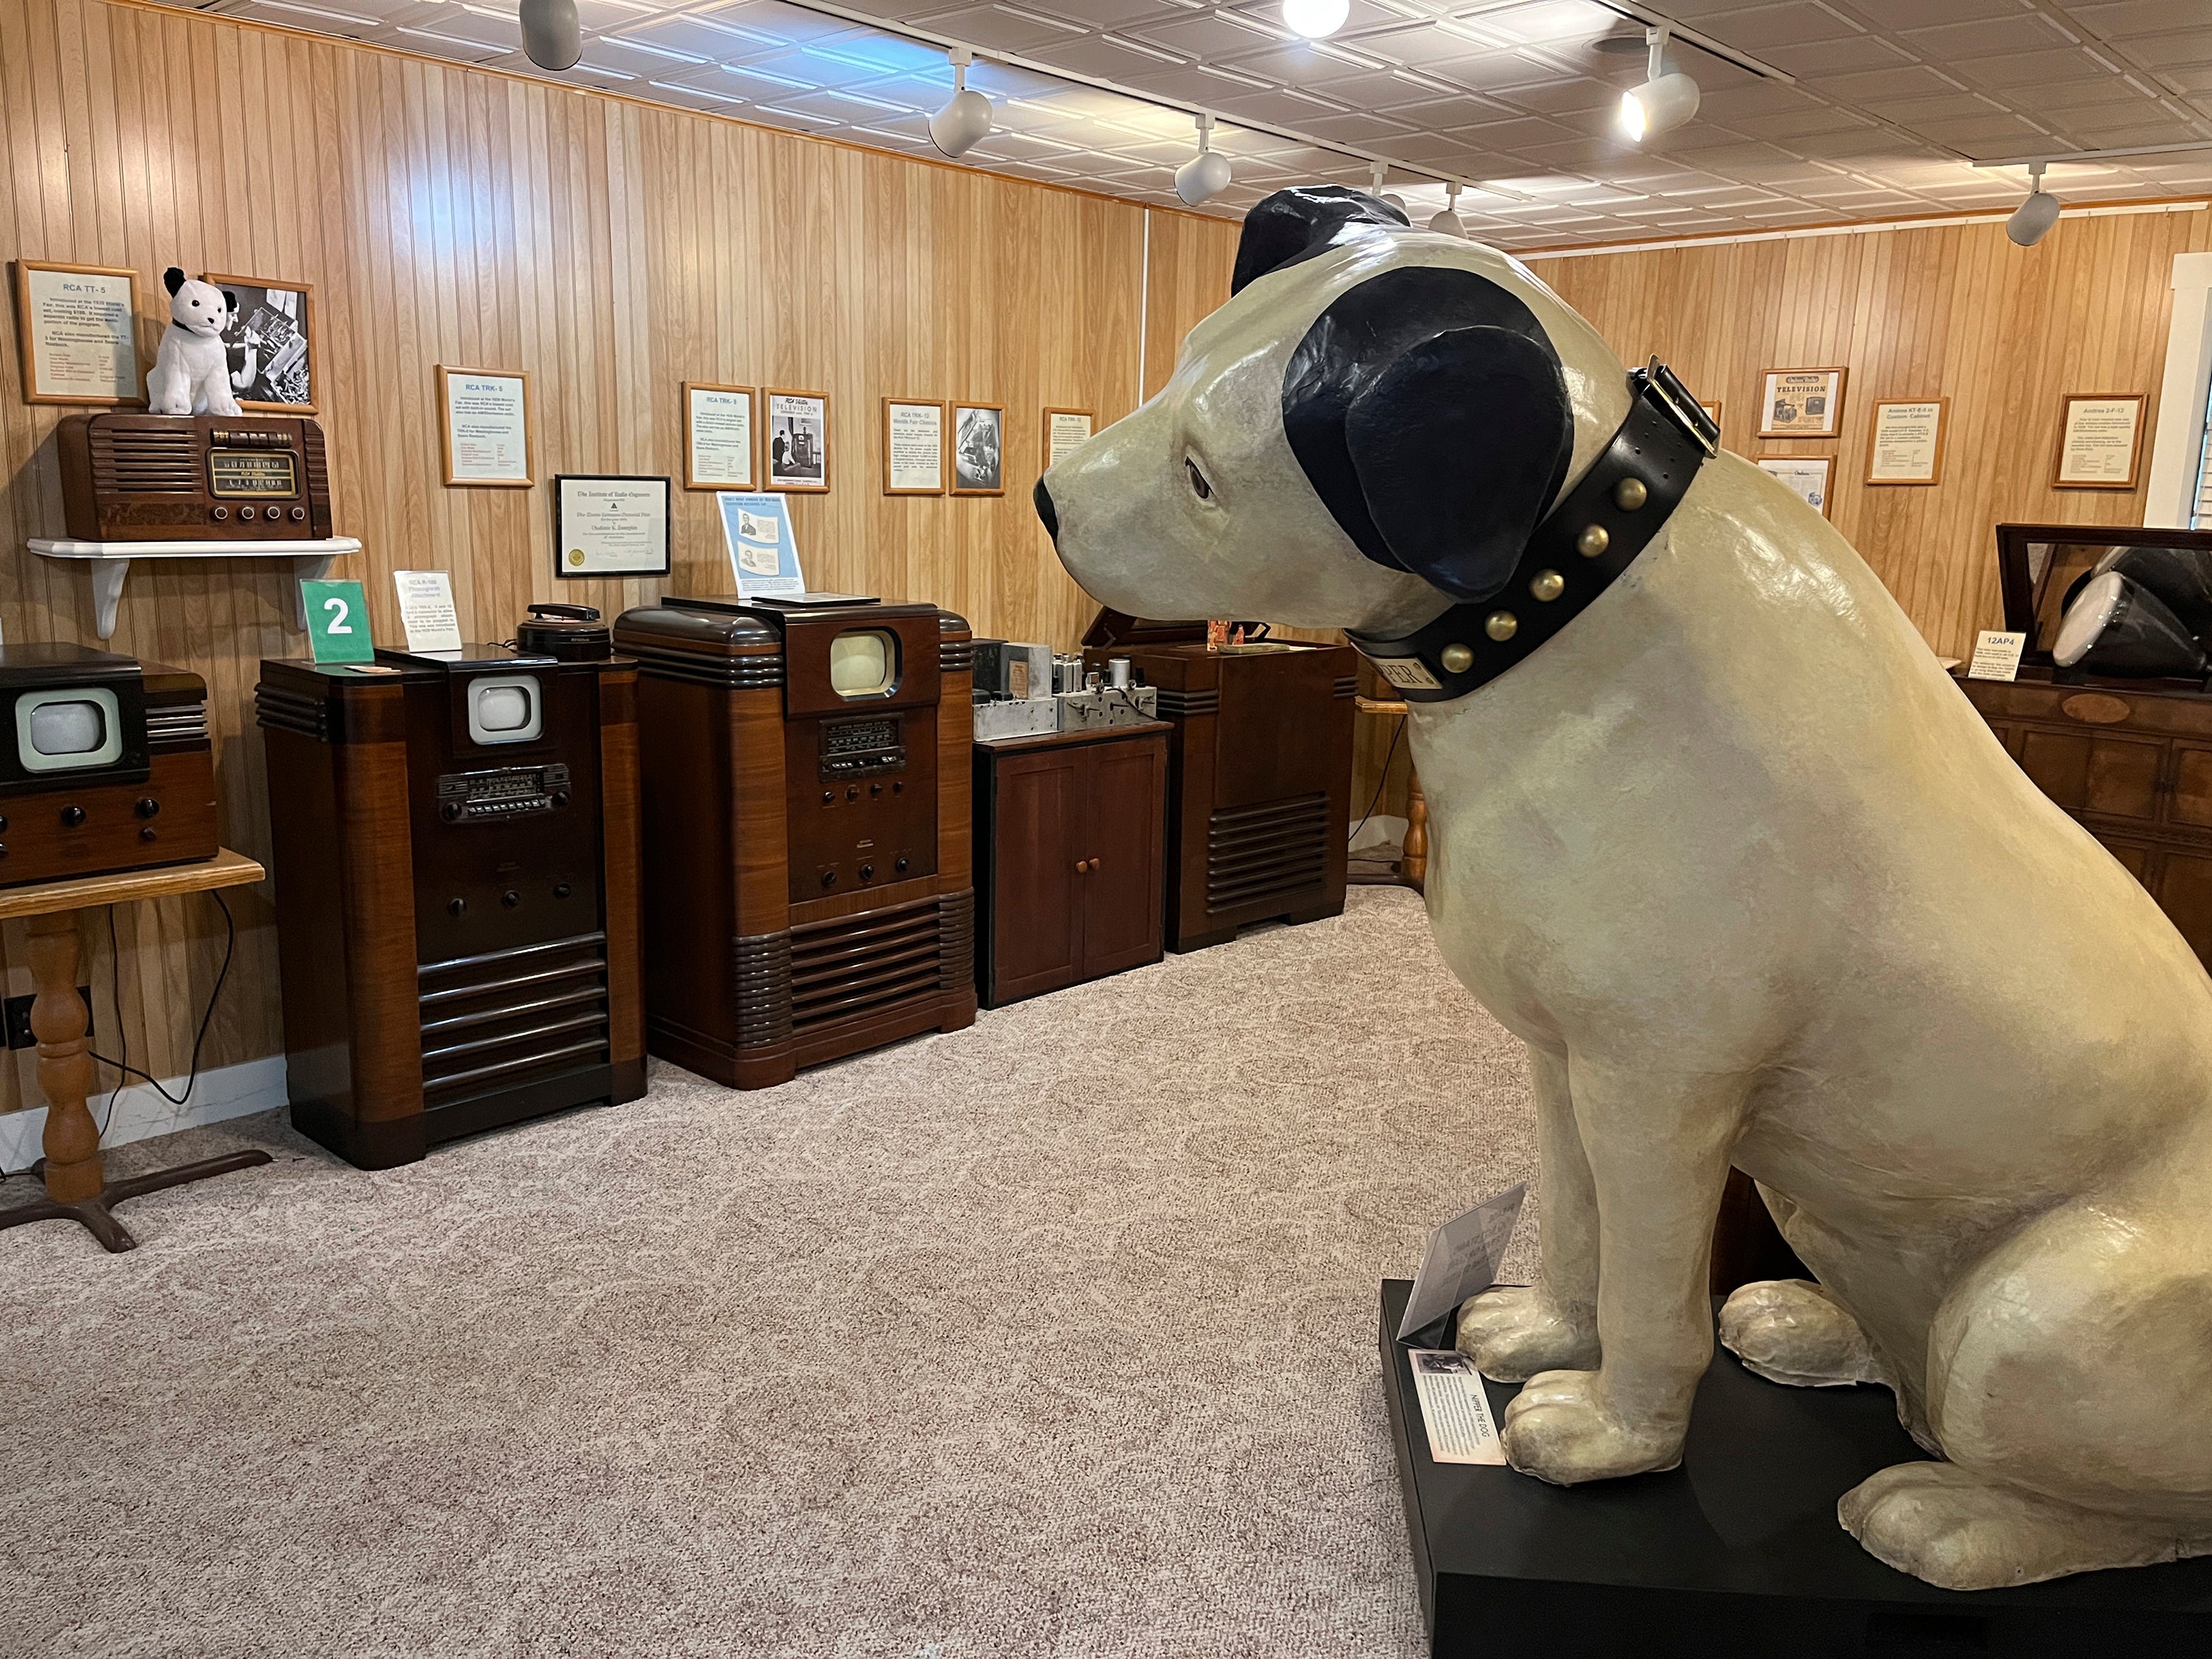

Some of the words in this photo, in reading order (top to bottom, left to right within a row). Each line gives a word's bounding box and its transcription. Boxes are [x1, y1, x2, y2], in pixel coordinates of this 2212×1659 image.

[63, 284, 82, 292] RCA
[776, 403, 817, 412] TELEVISION
[324, 597, 352, 634] 2
[1988, 636, 2014, 645] 12AP4
[1470, 1394, 1482, 1412] NIPPER
[1476, 1411, 1486, 1424] THE
[1479, 1423, 1490, 1438] DOG
